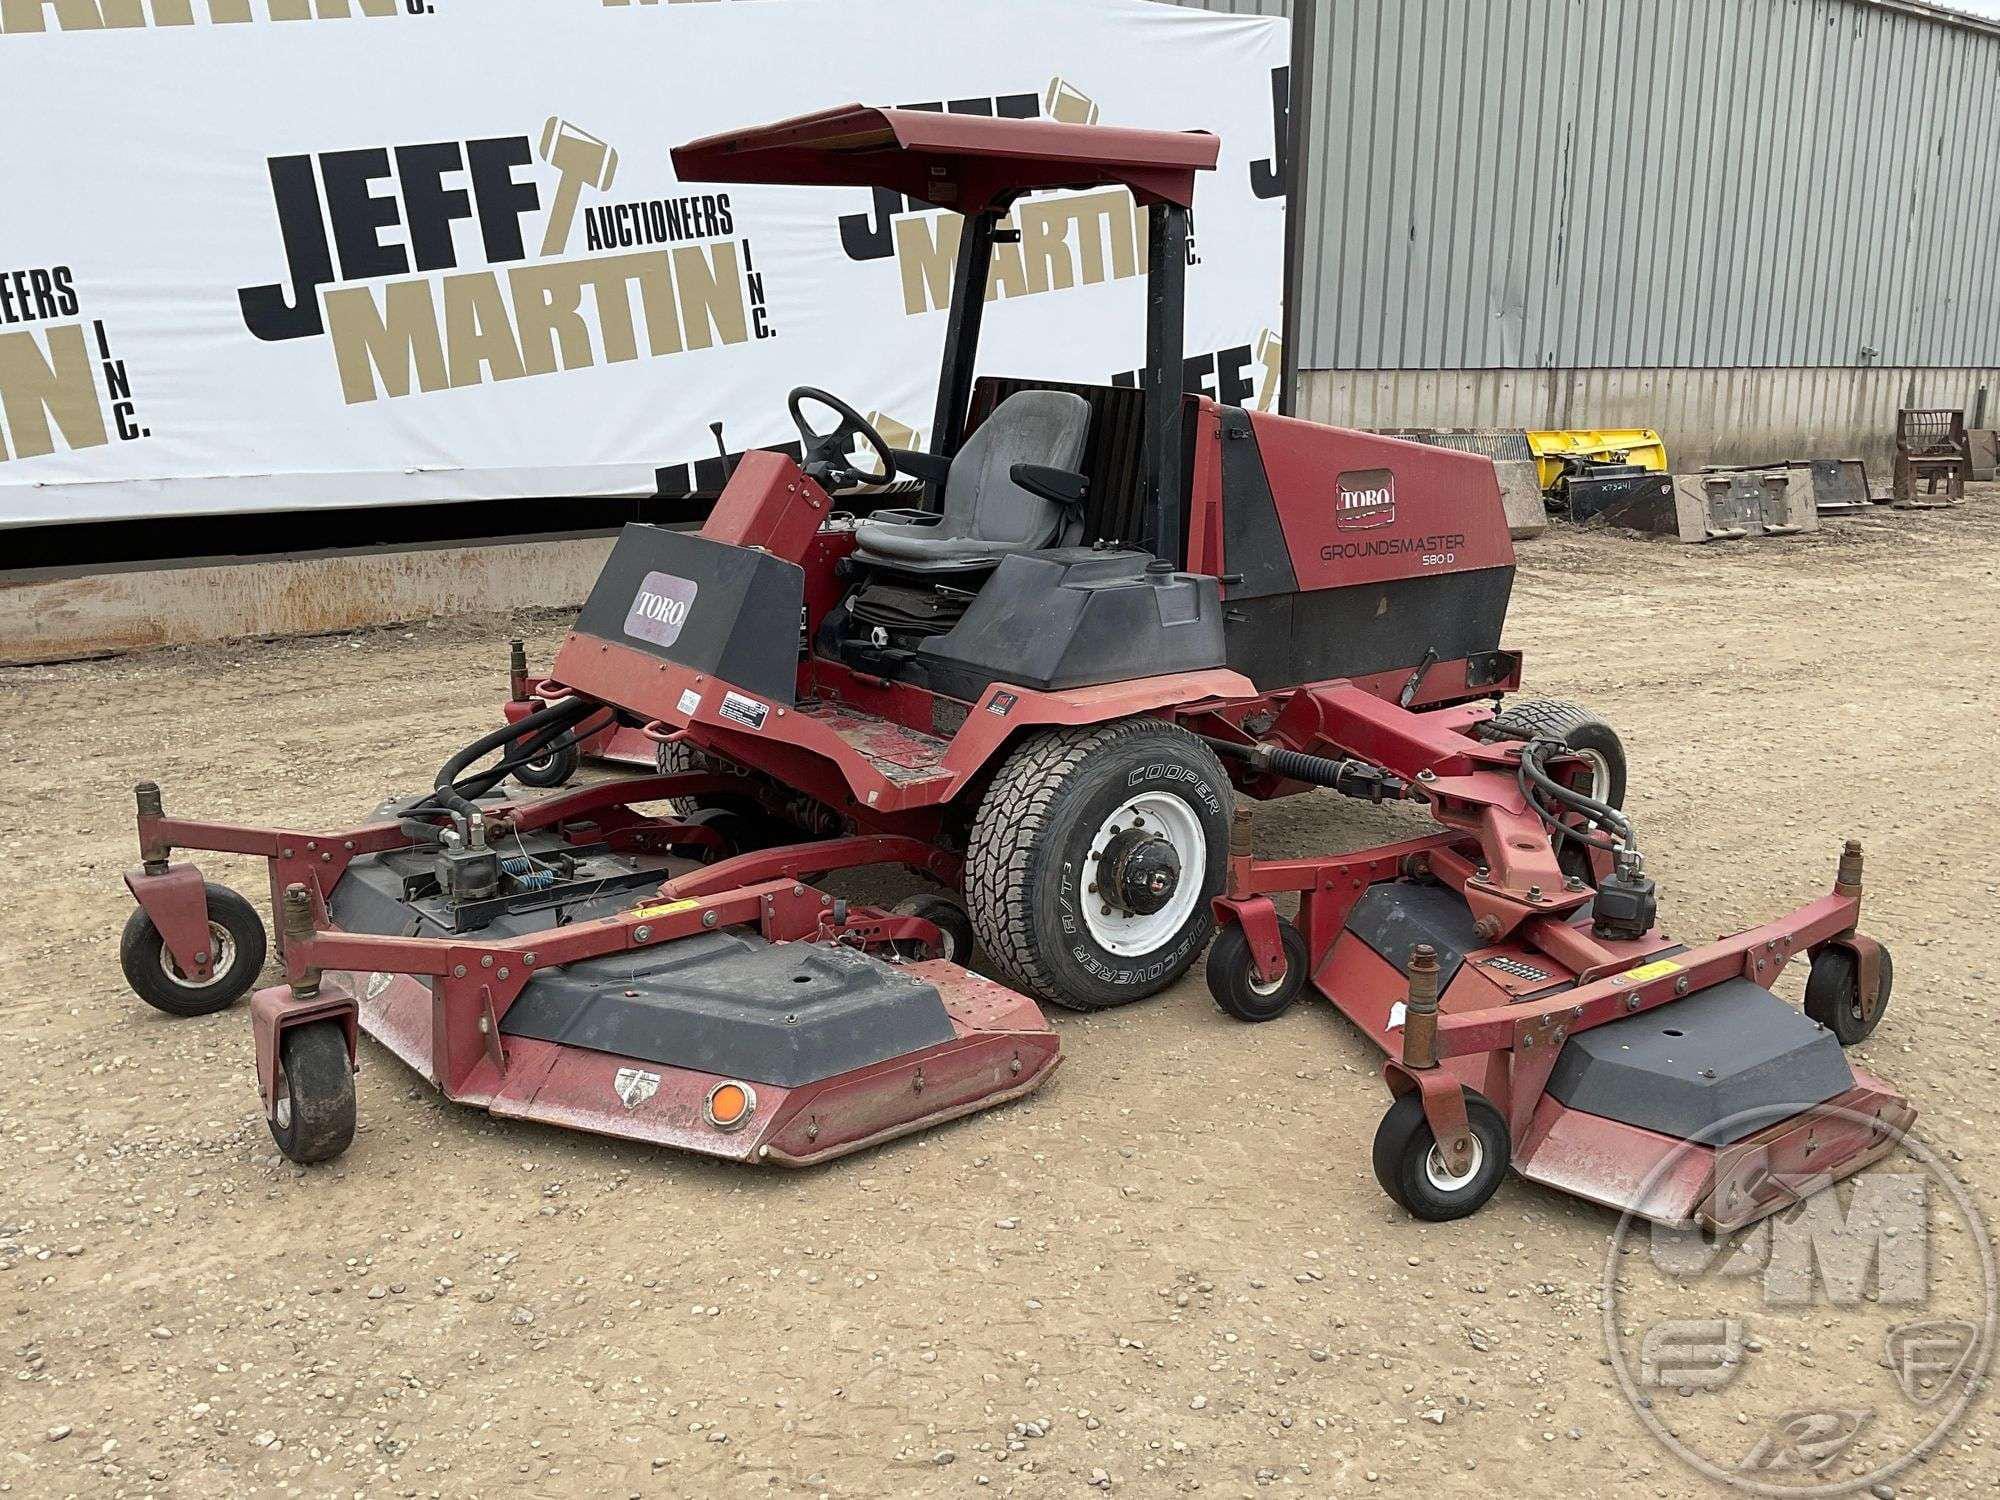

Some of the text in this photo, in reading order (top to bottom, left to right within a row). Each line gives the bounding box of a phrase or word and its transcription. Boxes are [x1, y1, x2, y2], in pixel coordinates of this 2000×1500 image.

[238, 135, 540, 341] JEFF
[585, 194, 734, 251] AUCTIONEERS
[895, 189, 1149, 316] MARTI
[323, 242, 749, 405] MARTIN
[742, 239, 777, 339] INC.
[93, 320, 151, 440] INC.
[1341, 488, 1390, 509] TORO
[1320, 534, 1465, 561] GROUNDSMASTER
[636, 591, 684, 625] TORO
[1128, 763, 1221, 816] COOPER
[1072, 914, 1209, 985] DISCOVERER
